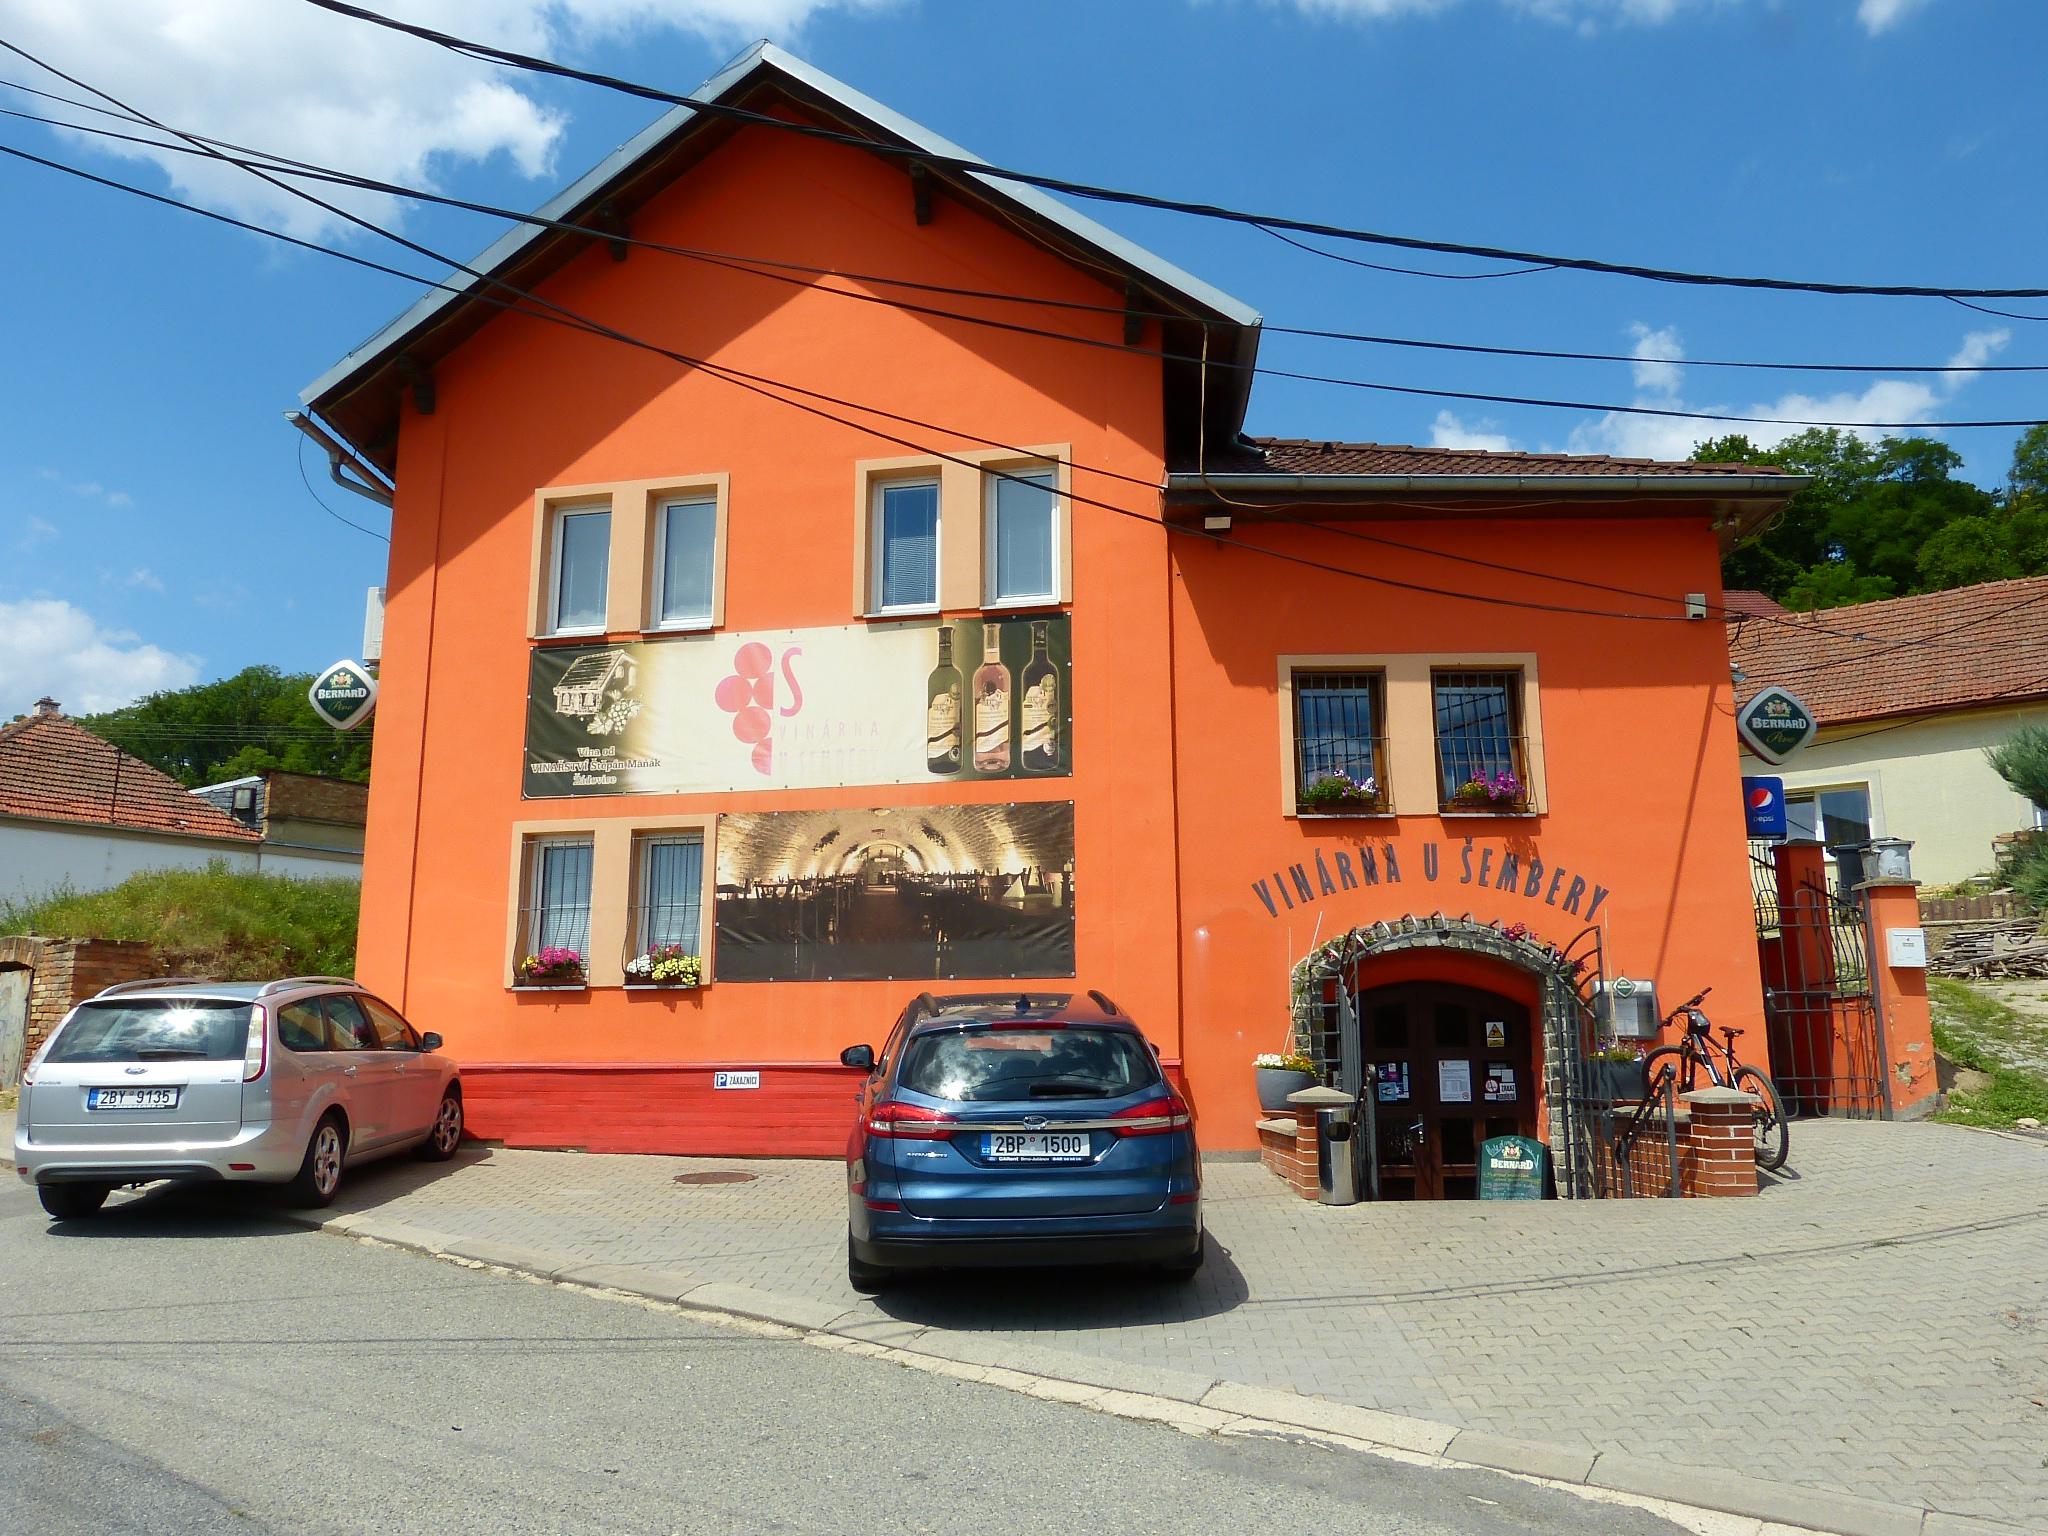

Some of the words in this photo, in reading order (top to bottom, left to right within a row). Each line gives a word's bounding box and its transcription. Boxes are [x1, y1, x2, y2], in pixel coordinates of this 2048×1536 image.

[318, 687, 367, 699] BERNARD
[1752, 717, 1807, 729] BERNARD
[602, 746, 616, 757] od
[1753, 814, 1774, 824] pepsi
[1251, 844, 1401, 918] VINÁRNA
[1423, 842, 1438, 881] U
[1460, 836, 1609, 922] ŠEMBERY
[100, 1090, 126, 1104] 2BY
[136, 1089, 171, 1104] 9135
[995, 1136, 1026, 1153] 2BP
[1041, 1136, 1081, 1153] 1500
[1490, 1158, 1534, 1170] BERNARD
